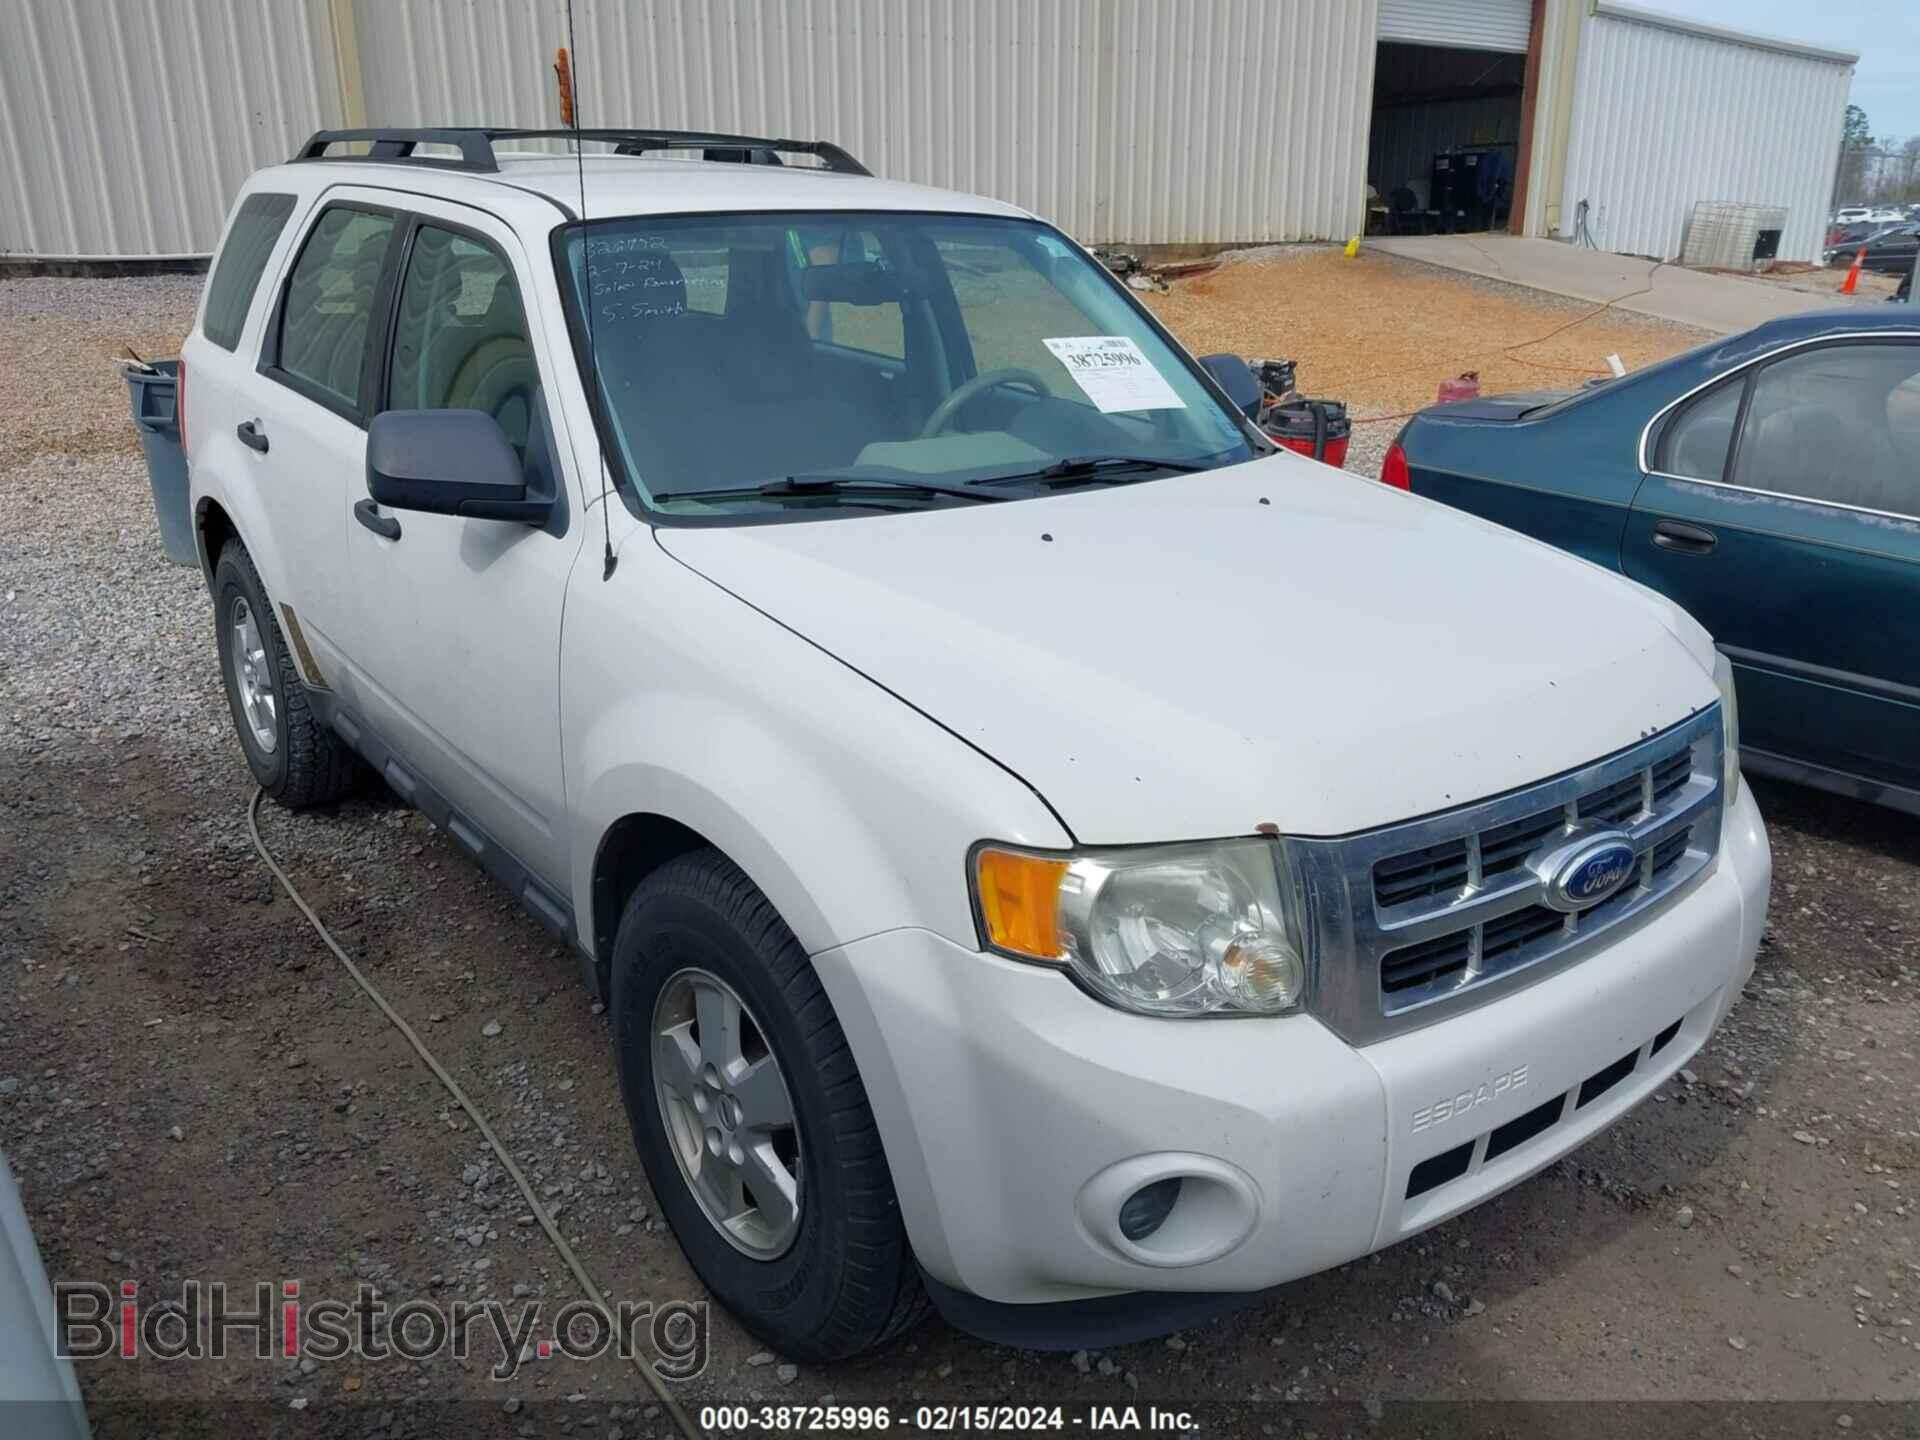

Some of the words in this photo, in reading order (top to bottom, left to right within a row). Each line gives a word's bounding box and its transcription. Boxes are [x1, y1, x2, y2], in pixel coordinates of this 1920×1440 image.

[1067, 351, 1142, 369] 38725996
[1583, 856, 1623, 894] Ford
[1411, 1064, 1528, 1134] ESCAPE
